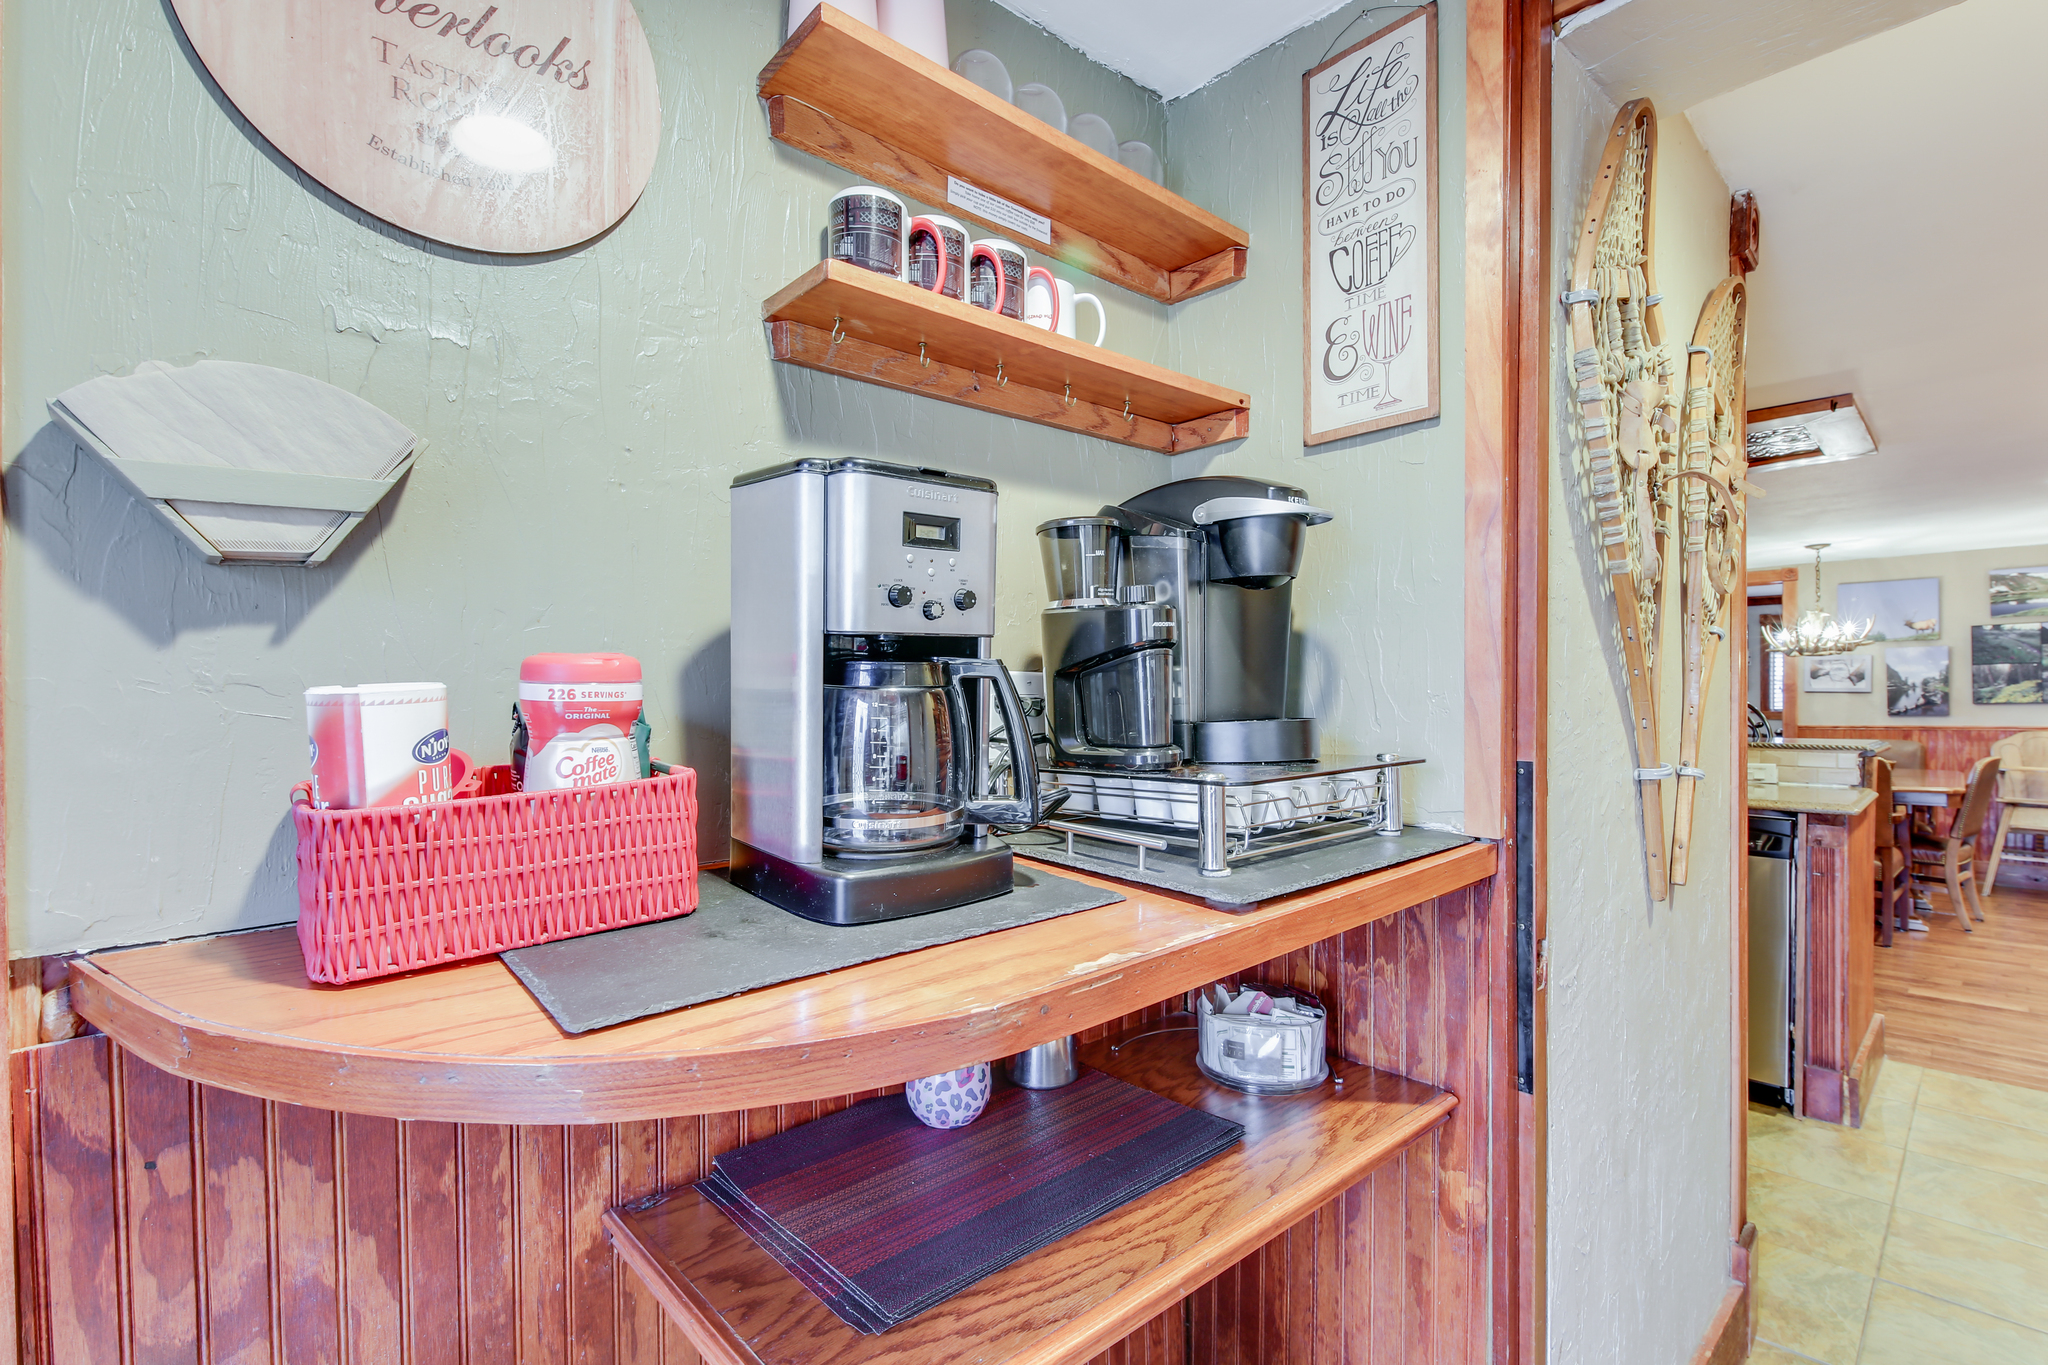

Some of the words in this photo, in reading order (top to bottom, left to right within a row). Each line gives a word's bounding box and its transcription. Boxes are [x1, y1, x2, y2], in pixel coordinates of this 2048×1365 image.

[1316, 36, 1414, 145] Life
[1320, 131, 1339, 151] is
[1367, 97, 1387, 122] all
[1389, 86, 1412, 112] the
[1375, 136, 1419, 180] YOU
[1326, 206, 1360, 229] HAVE
[1363, 197, 1381, 212] TO
[1385, 186, 1406, 203] DO
[1331, 213, 1398, 247] between
[1329, 222, 1404, 294] COFFEE
[1344, 286, 1387, 311] TIME
[1323, 315, 1361, 383] &
[1362, 294, 1413, 360] WINE
[1338, 385, 1381, 407] TIME
[906, 485, 959, 503] Cuisinart
[547, 688, 577, 700] 226
[581, 691, 625, 699] SERVINGS
[556, 753, 615, 779] Coffee
[572, 765, 618, 788] mate
